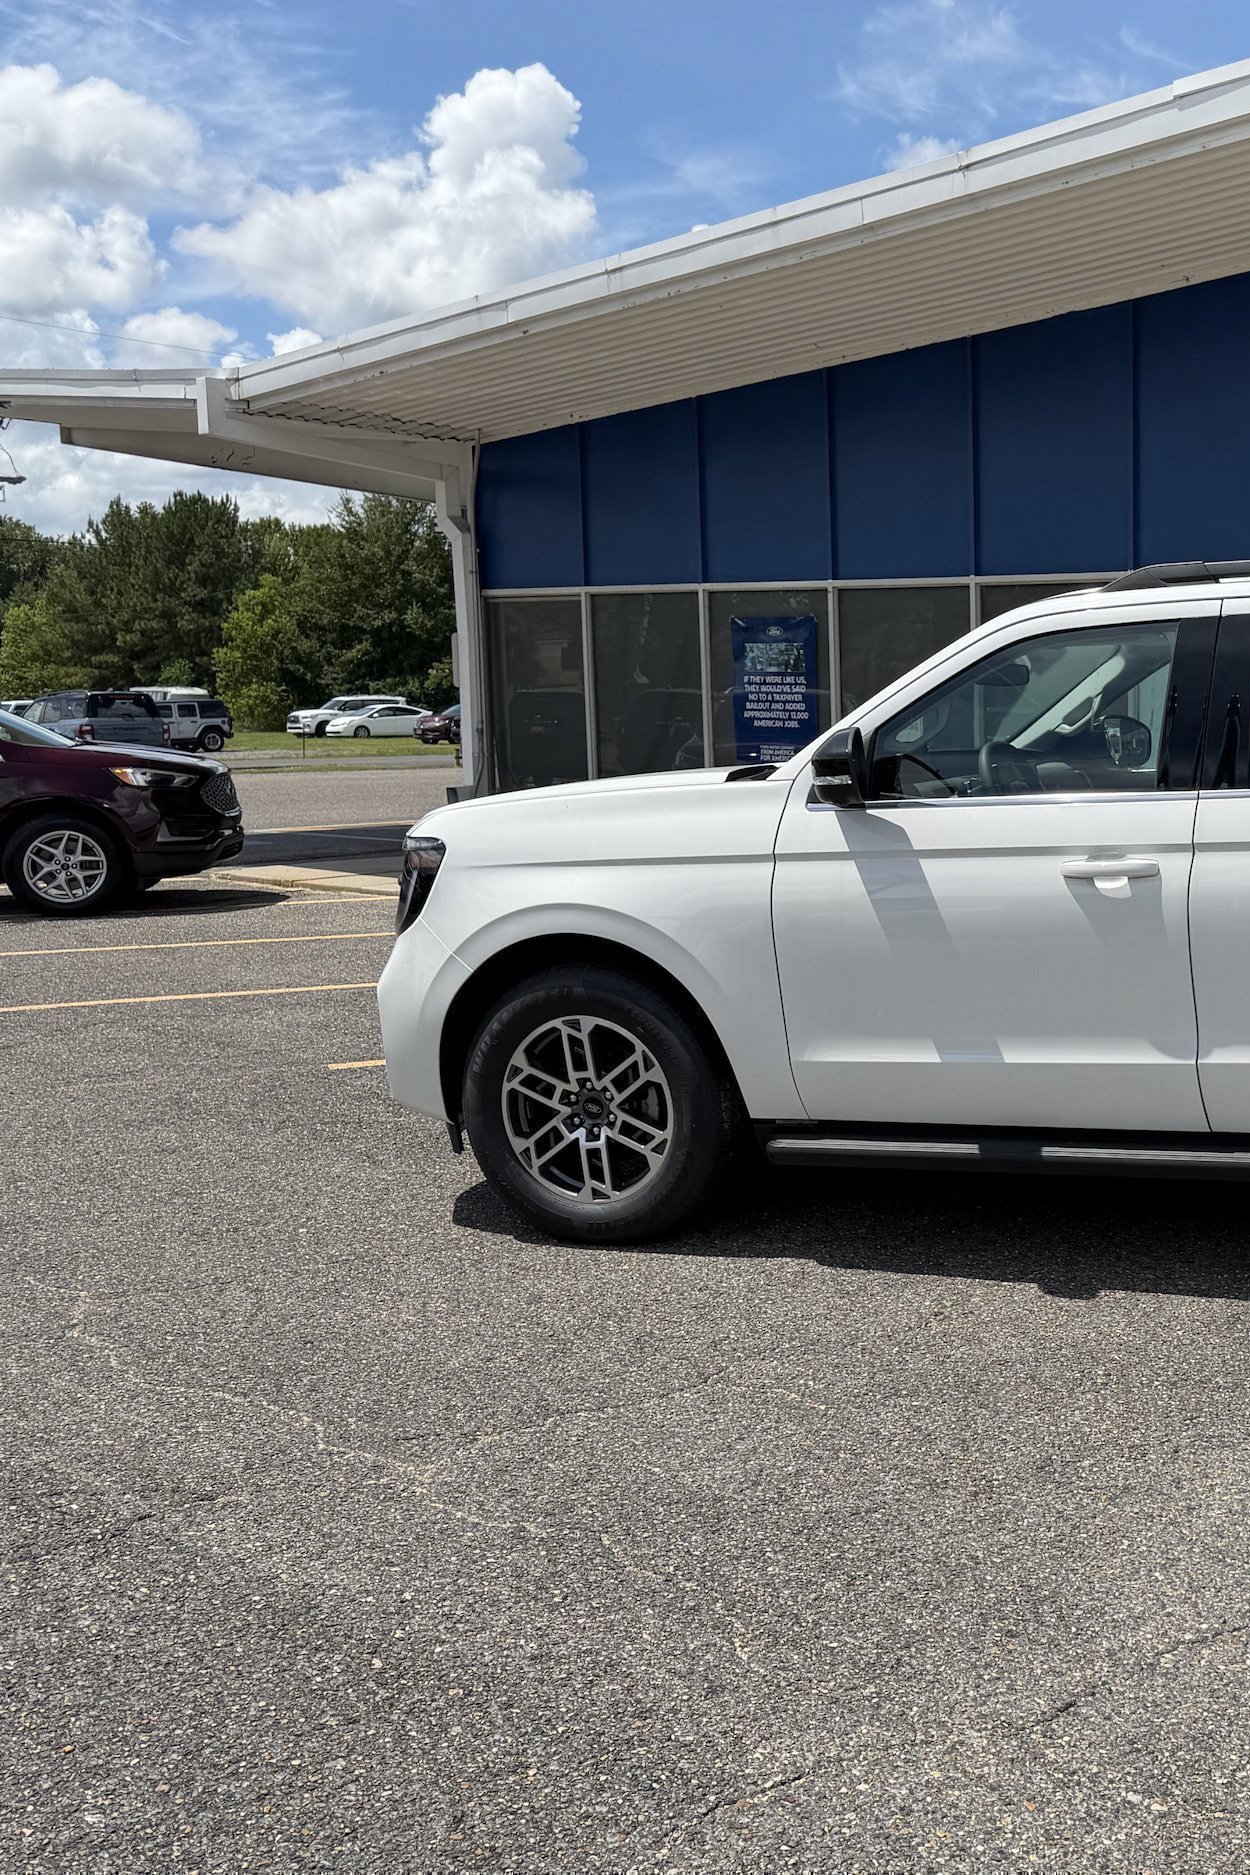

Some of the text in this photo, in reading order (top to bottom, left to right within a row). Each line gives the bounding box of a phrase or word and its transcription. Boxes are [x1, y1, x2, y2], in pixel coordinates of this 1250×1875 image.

[783, 676, 795, 684] LIKE
[796, 676, 807, 684] US,
[744, 684, 759, 692] THEY
[748, 693, 758, 701] NO
[771, 702, 784, 710] AND
[744, 711, 789, 719] APPROXIMATELY
[784, 720, 800, 728] JOBS.
